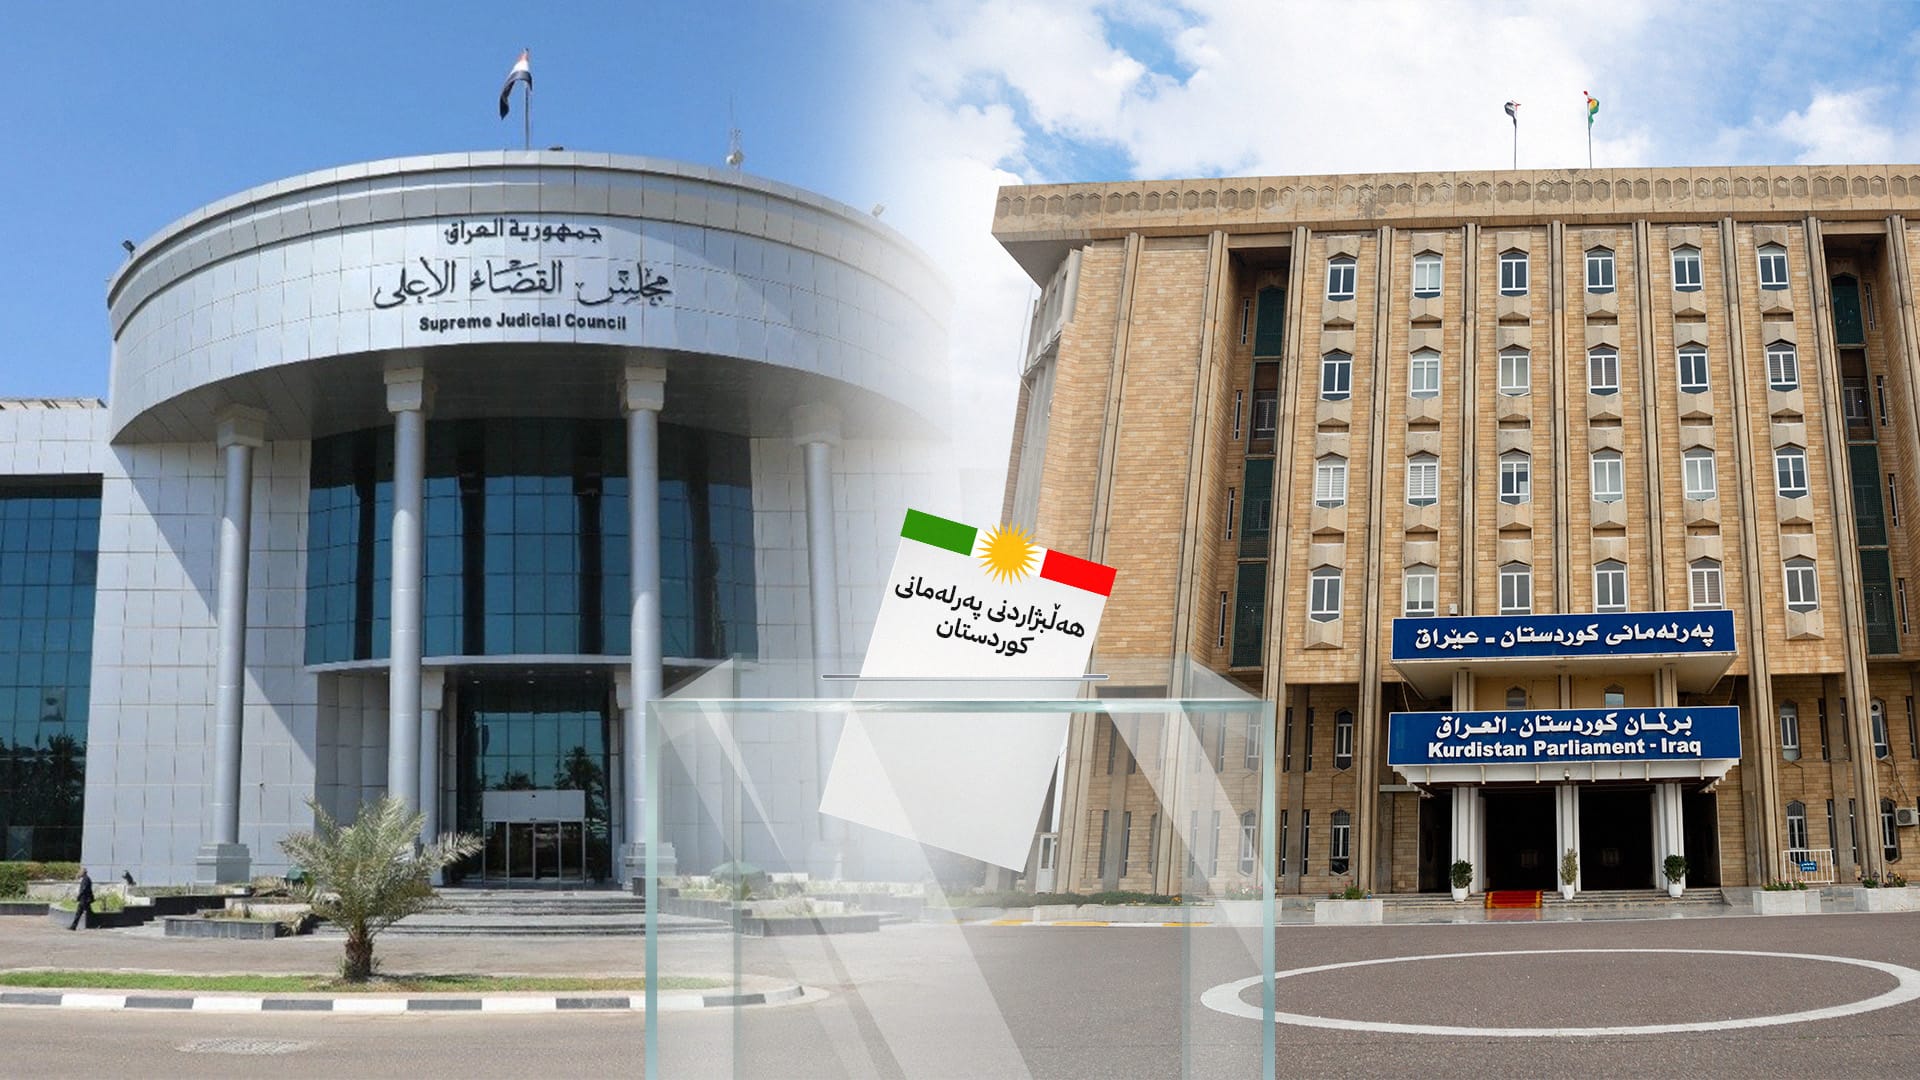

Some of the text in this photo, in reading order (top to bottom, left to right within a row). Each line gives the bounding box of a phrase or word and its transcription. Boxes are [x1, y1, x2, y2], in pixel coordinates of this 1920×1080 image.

[444, 217, 603, 244] جمهورية العراق
[470, 259, 563, 294] القضاء
[575, 262, 673, 307] مجلس
[419, 312, 627, 333] Supreme Judicial Council
[1436, 715, 1507, 739] العراق
[1624, 711, 1693, 737] برلمان
[1428, 741, 1527, 758] Kurdistan
[1533, 738, 1646, 756] Parliament
[1661, 737, 1702, 756] Iraq
